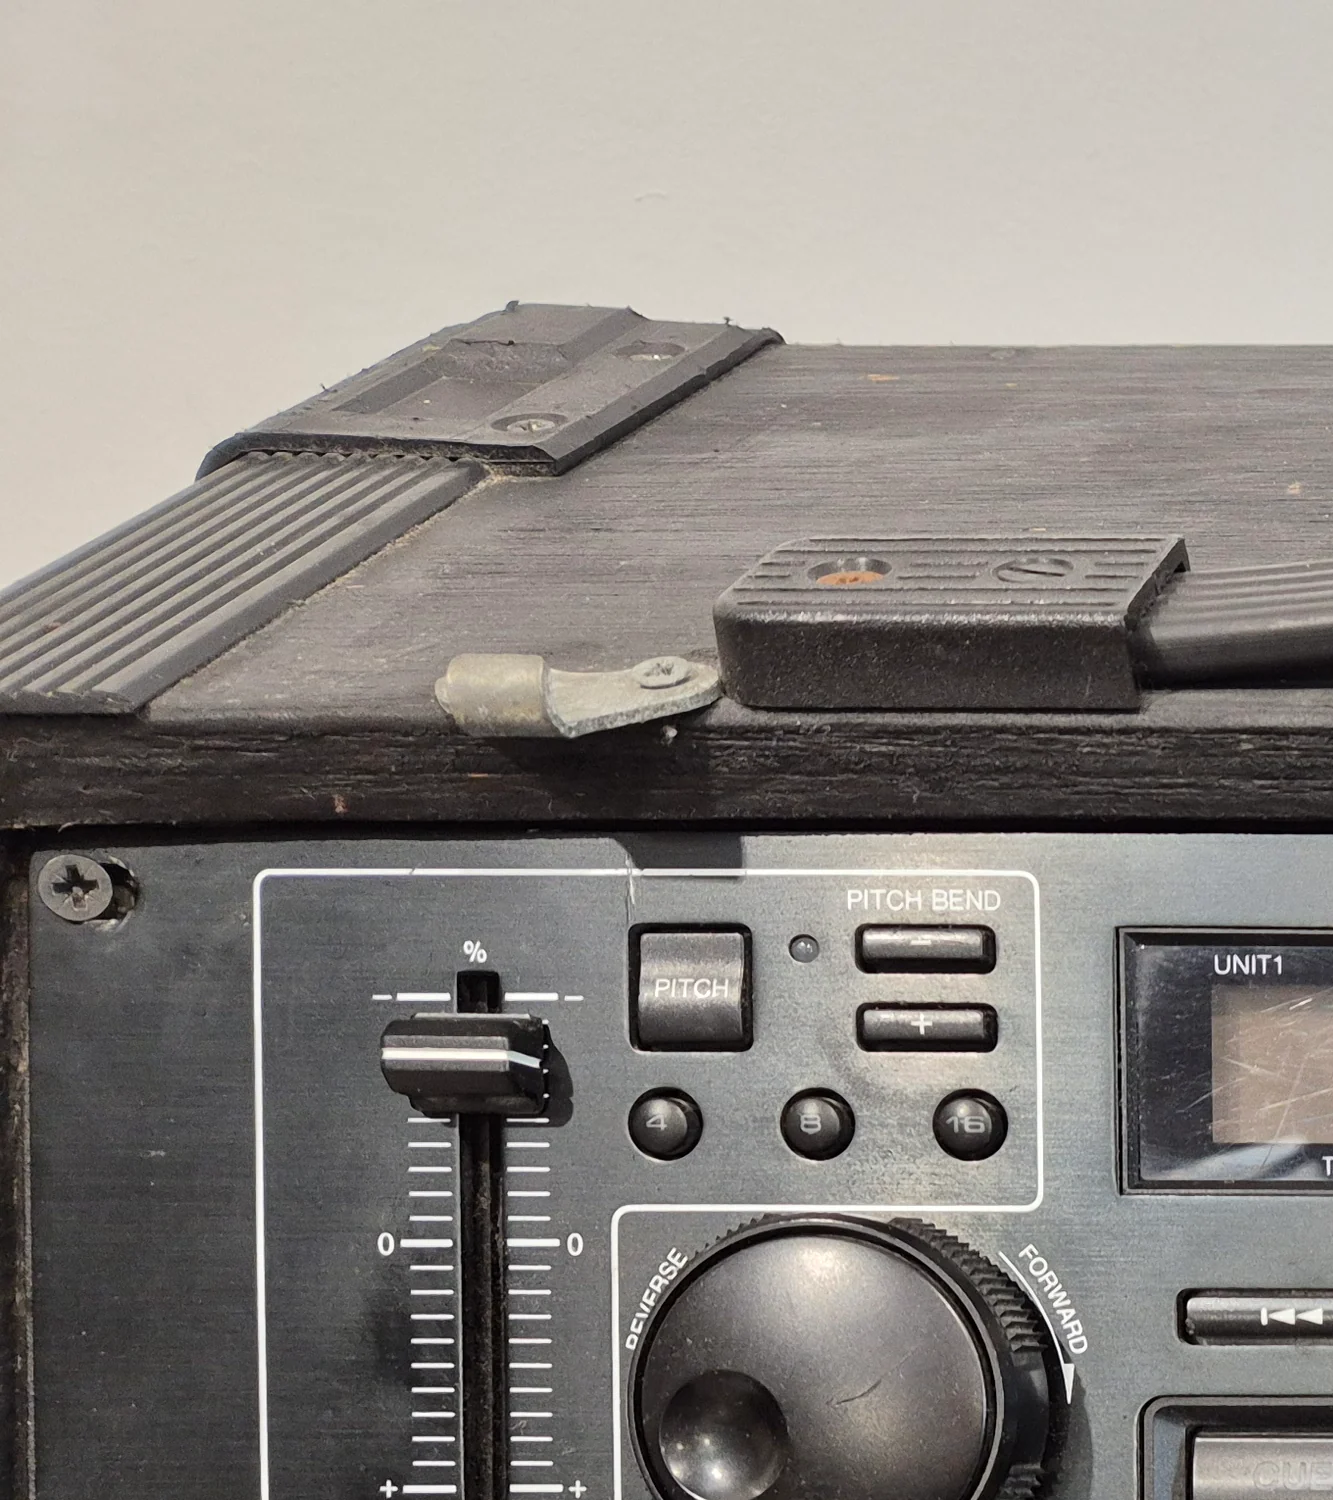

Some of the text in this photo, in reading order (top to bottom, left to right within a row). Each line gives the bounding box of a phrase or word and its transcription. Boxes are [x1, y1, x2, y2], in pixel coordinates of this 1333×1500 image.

[847, 888, 1001, 912] PITCH BEND
[1214, 953, 1282, 975] UNIT1
[654, 978, 729, 1001] PITCH
[646, 1113, 668, 1131] 4
[801, 1112, 822, 1135] 8
[944, 1114, 985, 1134] 16
[1016, 1243, 1089, 1356] FORWARD
[1253, 1461, 1332, 1491] CUE
